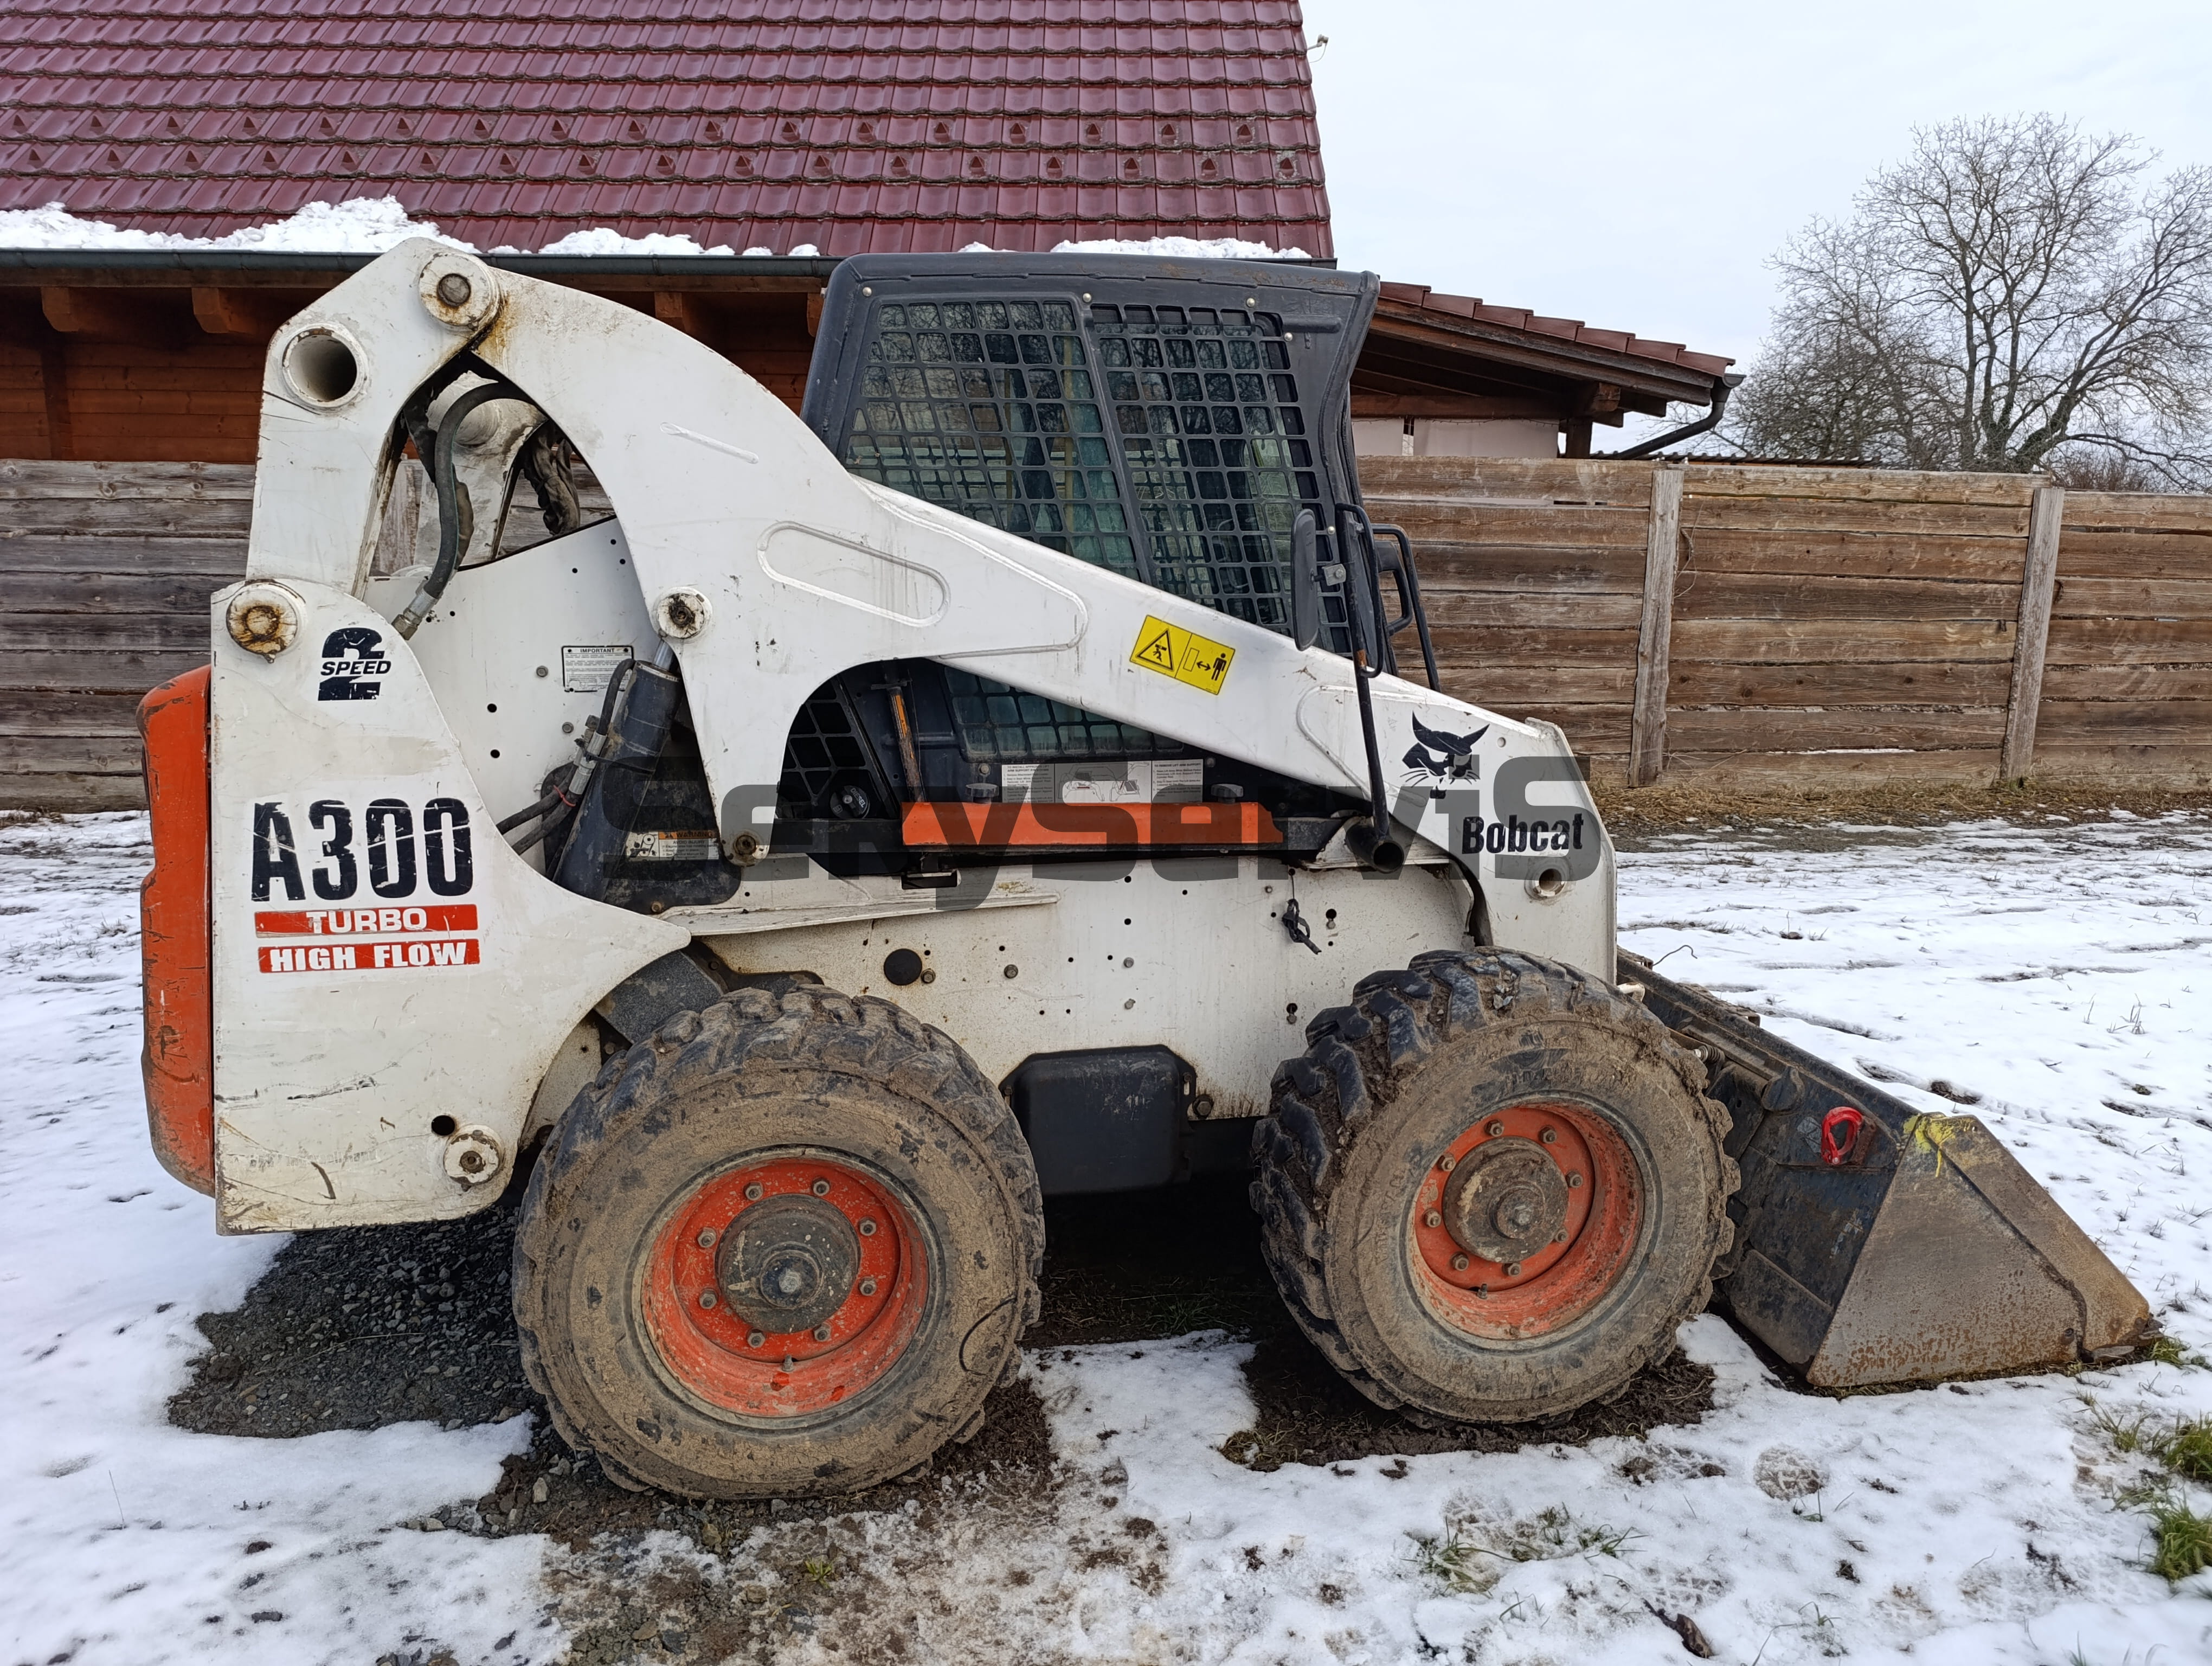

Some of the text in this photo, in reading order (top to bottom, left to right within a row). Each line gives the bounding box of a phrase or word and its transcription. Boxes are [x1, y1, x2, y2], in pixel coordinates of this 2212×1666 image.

[318, 627, 392, 701] 2 SPEED
[850, 787, 866, 808] DIESEL
[251, 798, 474, 901] A300
[1461, 813, 1585, 855] Bobcat
[306, 907, 428, 934] TURBO
[270, 941, 467, 972] HIGH FLOW
